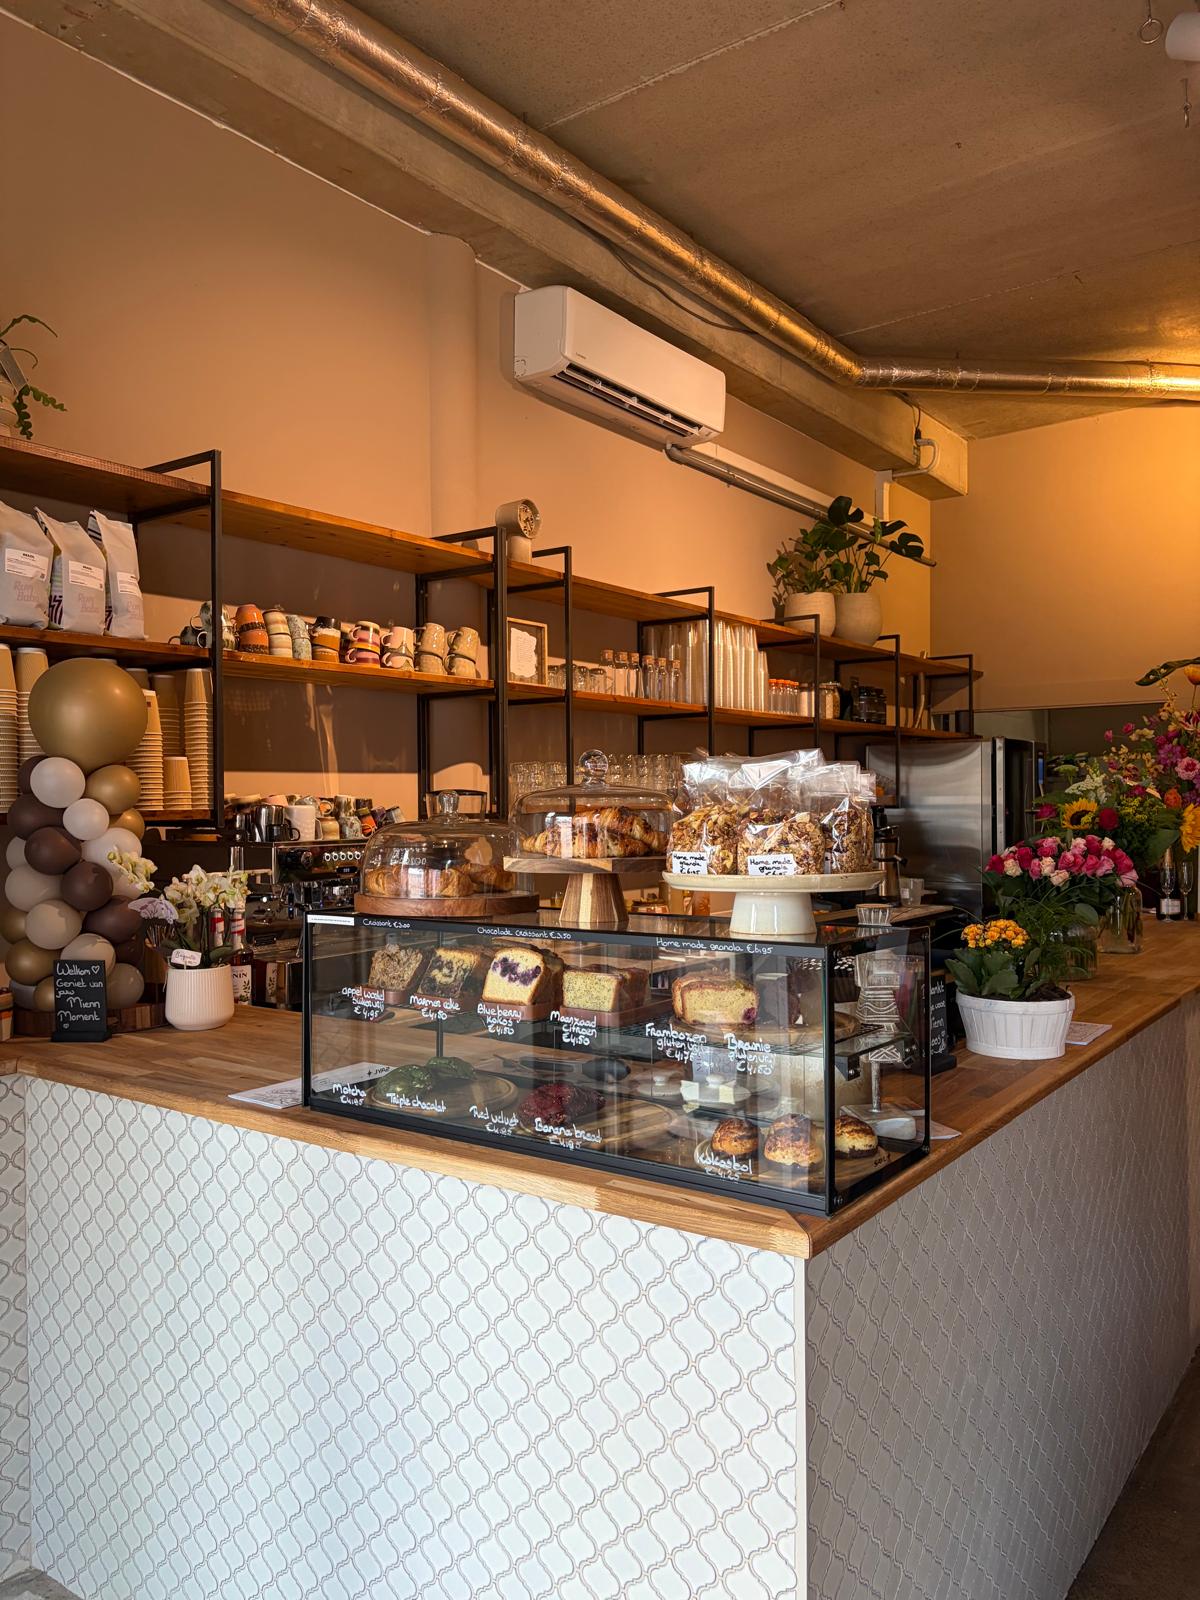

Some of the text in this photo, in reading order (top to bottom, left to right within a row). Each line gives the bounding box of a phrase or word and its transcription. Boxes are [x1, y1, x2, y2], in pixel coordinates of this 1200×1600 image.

[673, 853, 707, 861] Home made
[749, 857, 793, 866] Home made
[477, 926, 513, 937] Chocolade
[656, 936, 681, 948] Home
[682, 939, 707, 950] made
[709, 942, 743, 952] granola
[56, 962, 91, 976] Welkom
[56, 978, 87, 988] Geniet
[341, 985, 363, 998] appel
[57, 1010, 101, 1022] Moment
[477, 1003, 522, 1024] Blueberry
[645, 1022, 707, 1044] Frambozen
[332, 1082, 367, 1098] Matcha
[386, 1092, 411, 1109] Triple
[469, 1105, 490, 1120] Red
[534, 1117, 603, 1144] Banana bread
